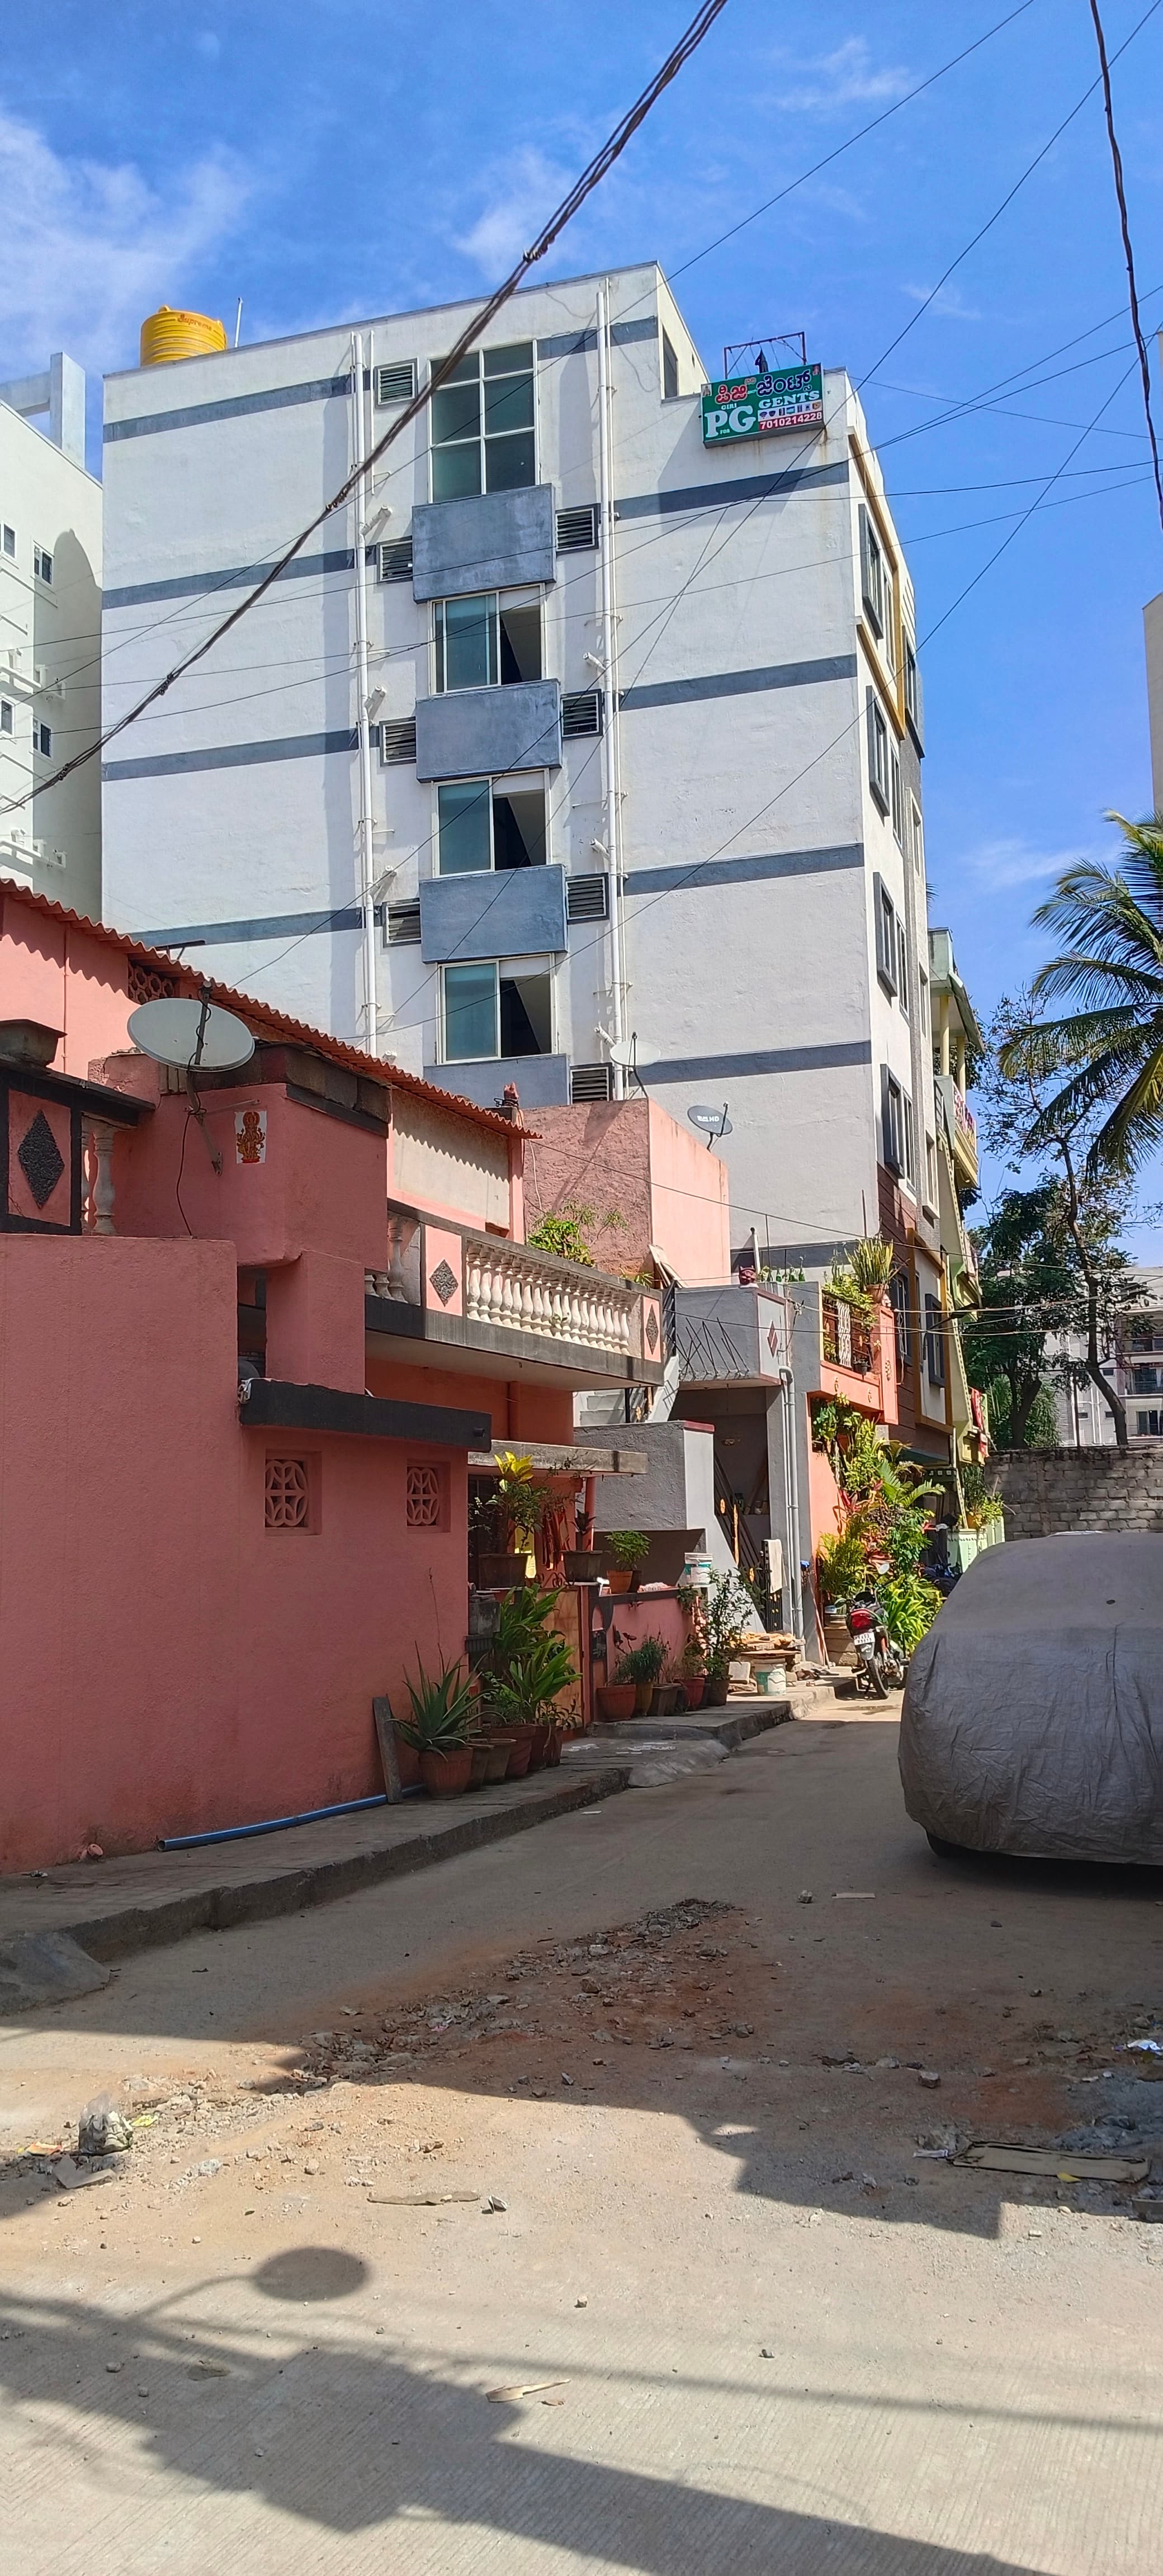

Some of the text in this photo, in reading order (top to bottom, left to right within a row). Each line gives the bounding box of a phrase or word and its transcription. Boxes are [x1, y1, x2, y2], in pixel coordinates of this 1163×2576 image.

[759, 391, 820, 409] GENTS
[705, 405, 756, 438] PG
[760, 412, 822, 429] 7010214228
